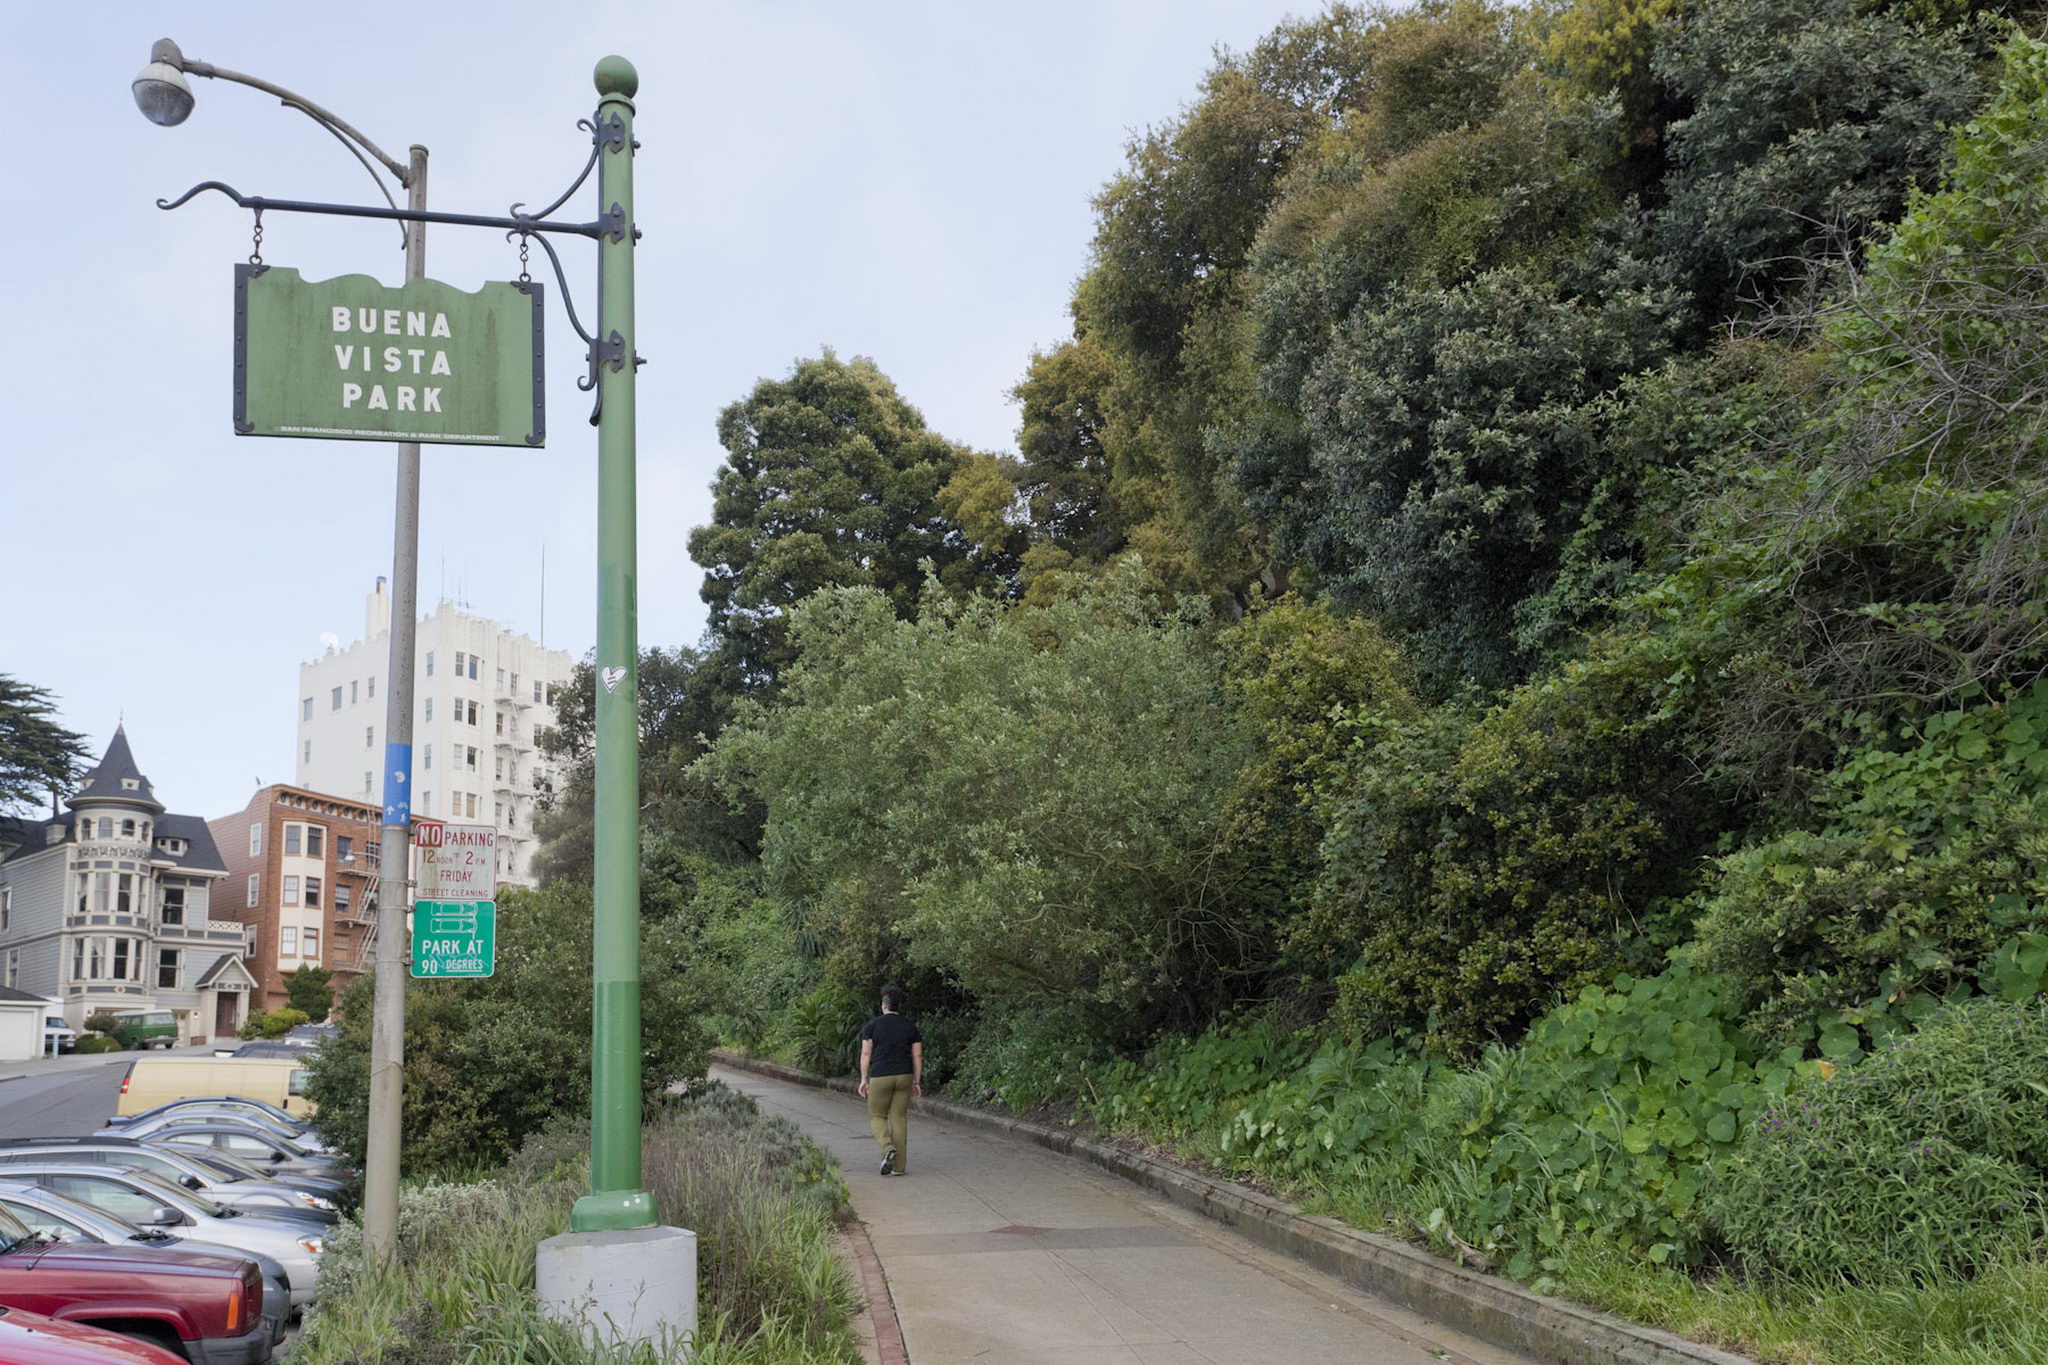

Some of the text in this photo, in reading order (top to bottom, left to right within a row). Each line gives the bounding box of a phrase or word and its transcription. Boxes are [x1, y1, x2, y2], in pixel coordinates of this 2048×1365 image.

[332, 306, 451, 338] BUENA
[334, 345, 451, 376] VISTA
[343, 382, 442, 413] PARK
[302, 427, 353, 435] FRANCISCO
[354, 430, 410, 438] RECREATION
[420, 826, 494, 847] NO PARKING
[423, 849, 435, 864] 12
[437, 856, 453, 864] NOON
[466, 850, 474, 865] 2
[440, 870, 472, 882] FRIDAY
[422, 888, 488, 897] STREET CLEANING
[422, 940, 484, 954] PARK AT
[422, 959, 483, 974] 90 DEGREES
